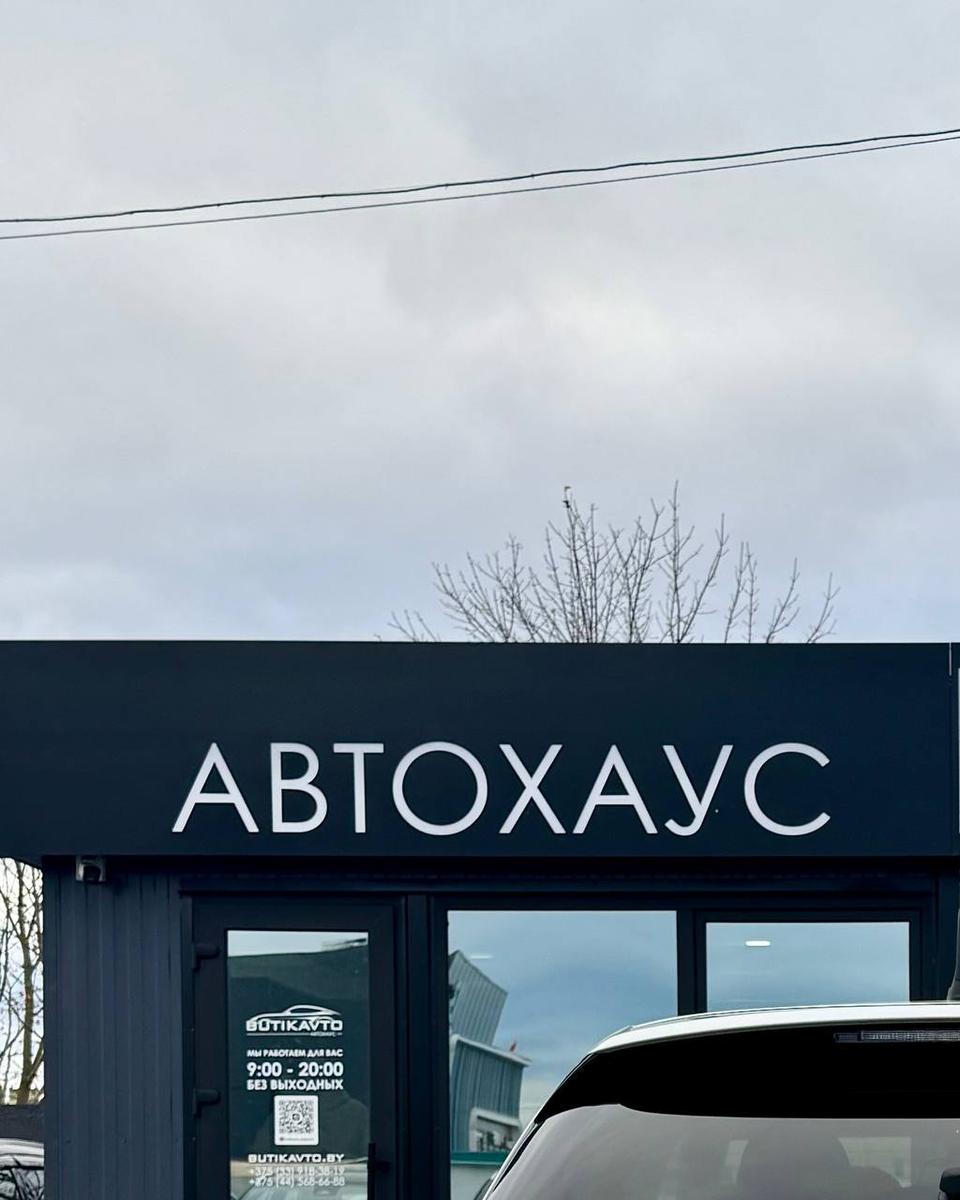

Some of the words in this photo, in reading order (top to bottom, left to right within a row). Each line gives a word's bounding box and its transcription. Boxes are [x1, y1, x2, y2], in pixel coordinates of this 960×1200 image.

[172, 741, 830, 836] АВТОХАУС
[245, 1020, 343, 1032] BUTIKAVTO
[247, 1049, 262, 1057] МЫ
[263, 1049, 306, 1057] РАБОТАЕМ
[307, 1049, 324, 1058] ДЛЯ
[325, 1049, 343, 1057] ВАС
[247, 1062, 282, 1077] 9:00
[298, 1062, 344, 1077] 20:00
[247, 1080, 267, 1090] БЕЗ
[270, 1079, 343, 1091] ВЫХОДНЫХ
[248, 1153, 344, 1163] BUTIKAVTO.BY
